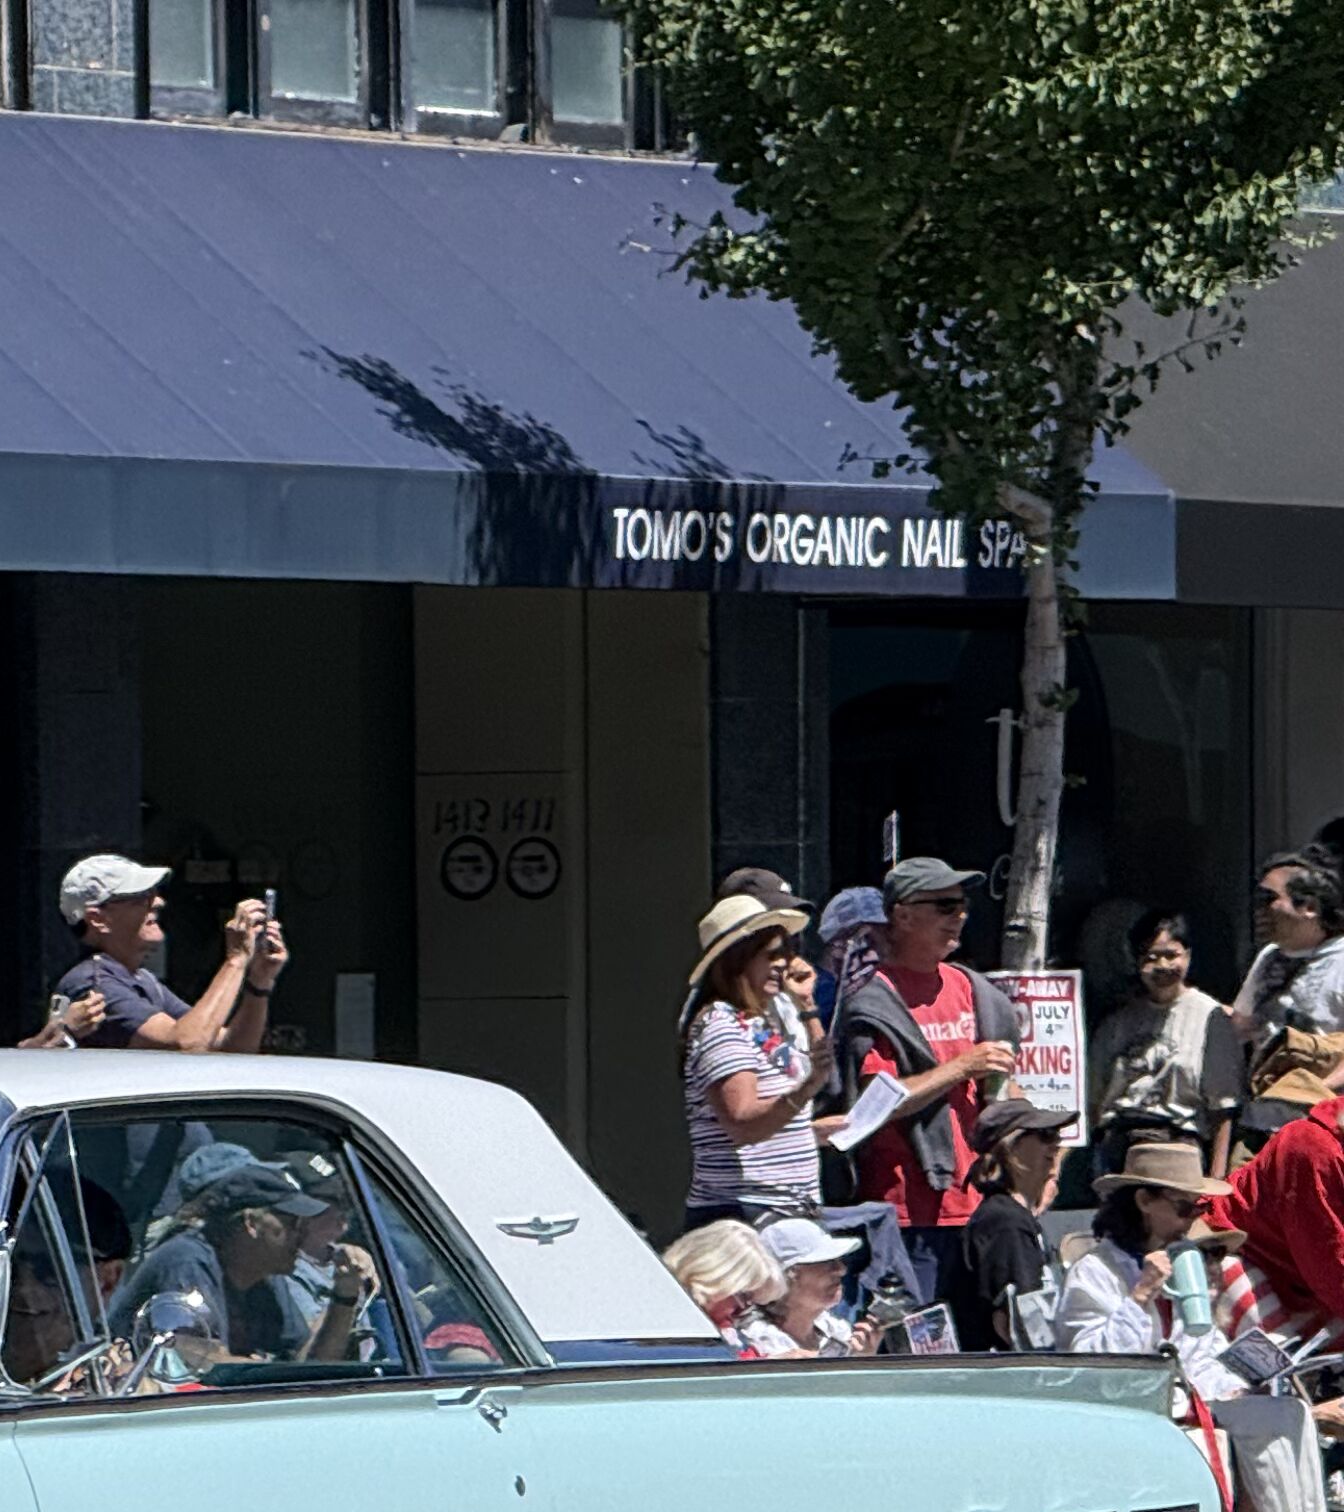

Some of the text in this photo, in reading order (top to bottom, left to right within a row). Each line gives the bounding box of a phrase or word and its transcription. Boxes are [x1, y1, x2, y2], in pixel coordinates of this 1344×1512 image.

[613, 508, 734, 561] TOMO'S
[746, 513, 891, 568] ORGANIC
[902, 517, 966, 568] NAIL
[1035, 1005, 1070, 1020] JULY
[1013, 1045, 1072, 1075] RKING
